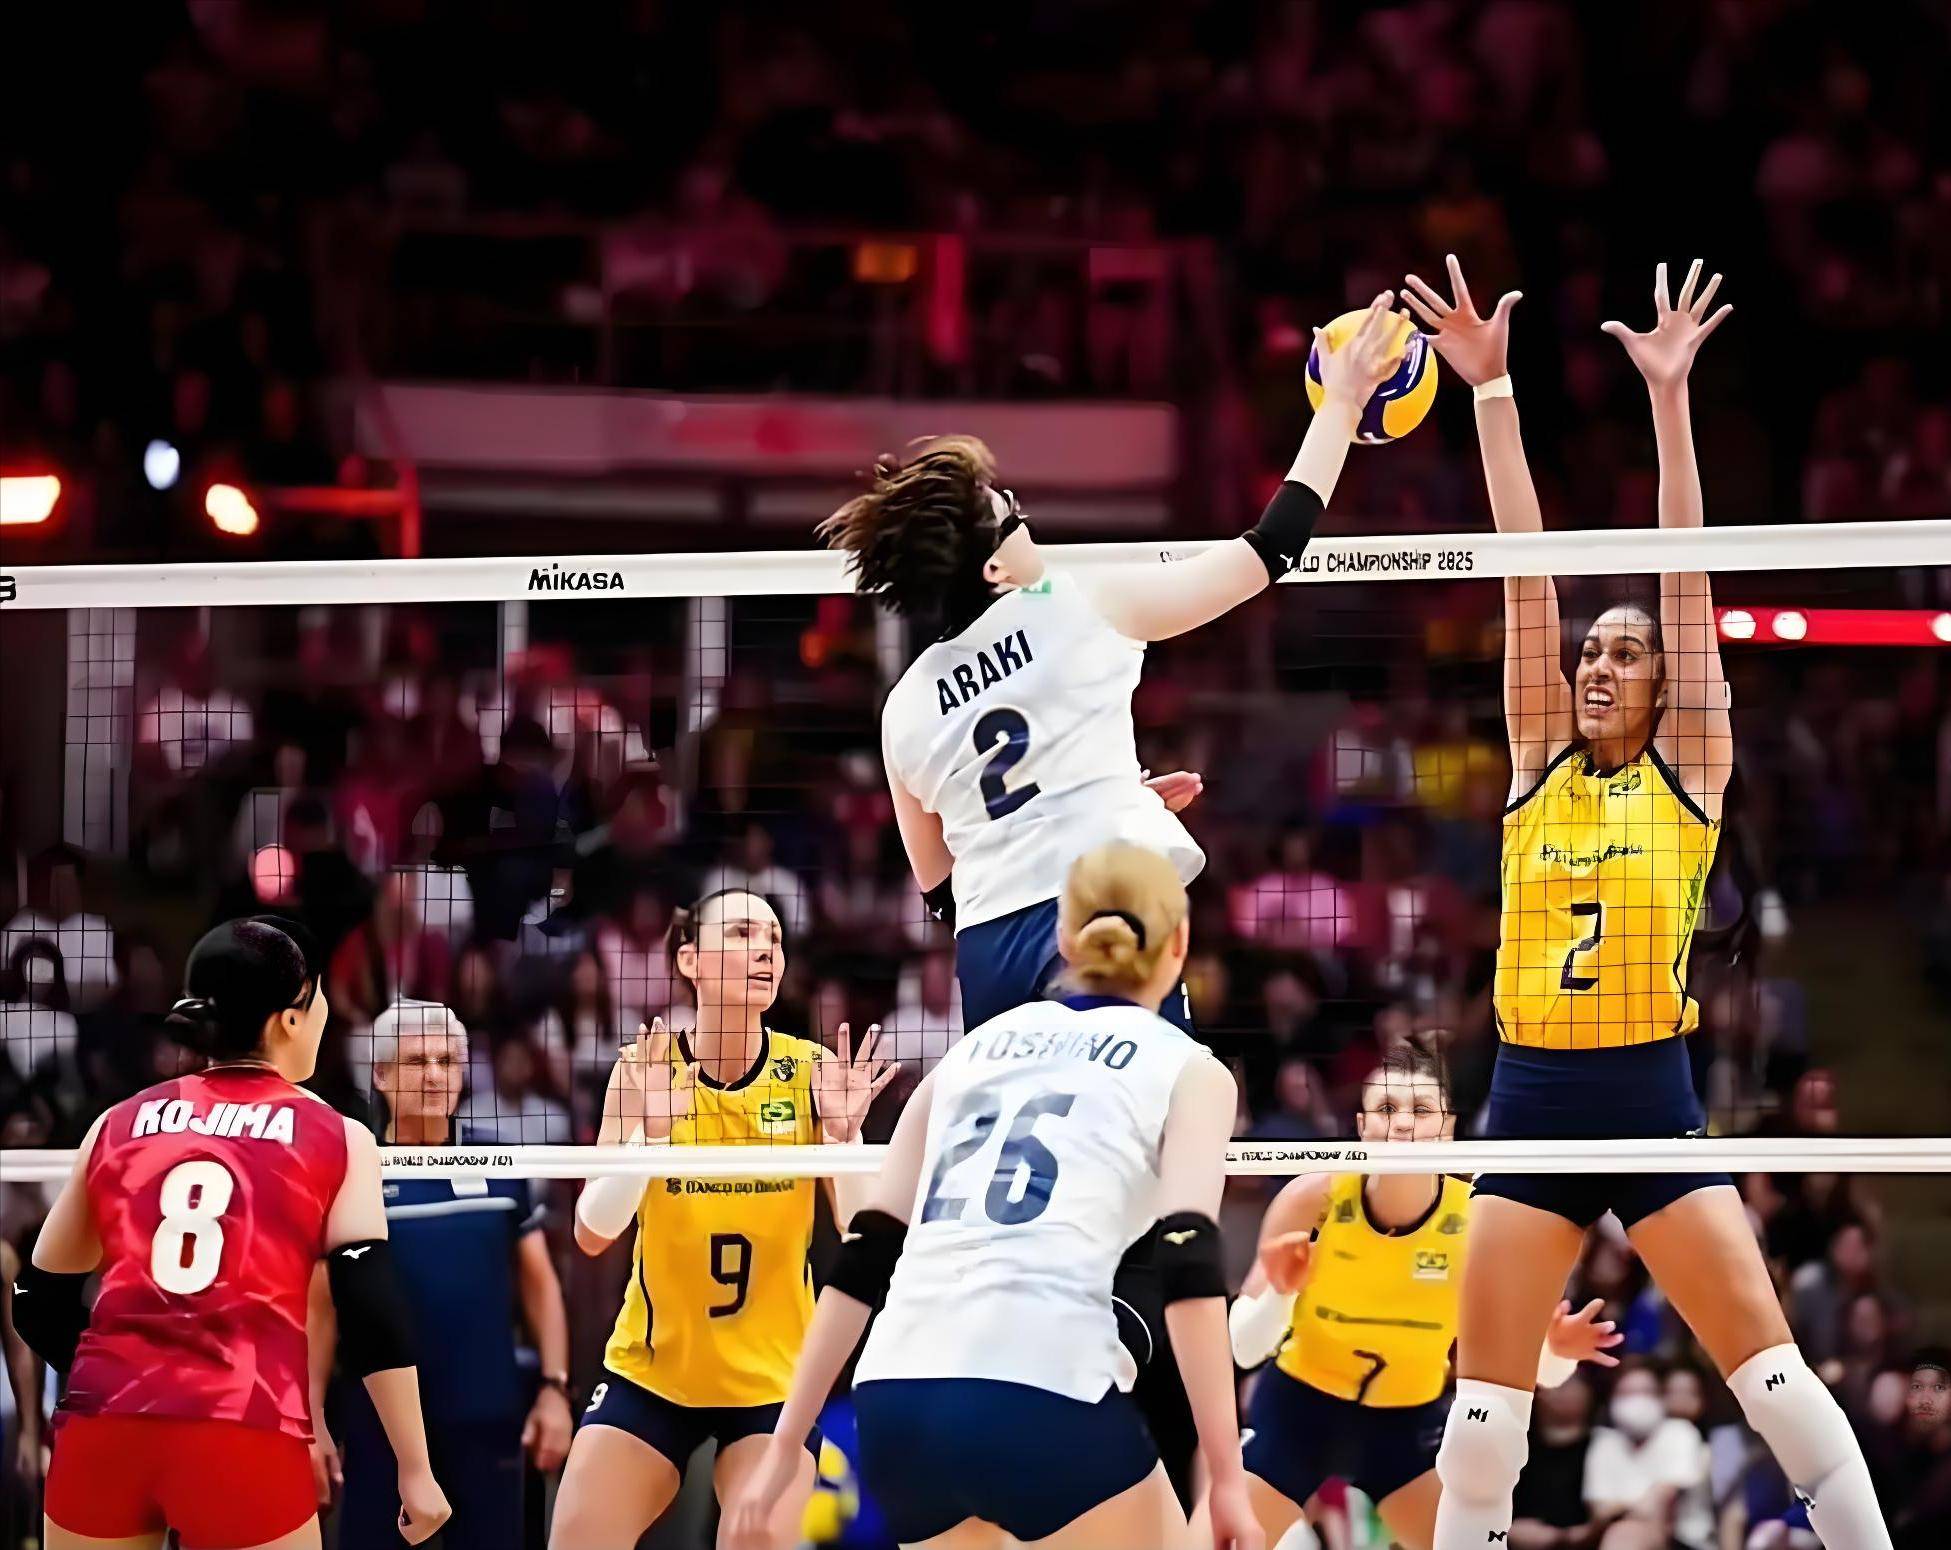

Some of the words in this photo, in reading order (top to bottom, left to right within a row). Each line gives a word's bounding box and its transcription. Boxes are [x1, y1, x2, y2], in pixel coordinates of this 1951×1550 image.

[1327, 551, 1432, 572] CHAMPIONSHIP
[936, 629, 1034, 716] ARAKI
[973, 707, 1041, 820] 2
[1560, 902, 1603, 991] 2
[131, 1098, 295, 1145] KOJIMA
[921, 1089, 1076, 1226] 26
[151, 1161, 234, 1295] 8
[709, 1232, 752, 1318] 9
[586, 1383, 609, 1413] 9
[1352, 1349, 1388, 1403] 7
